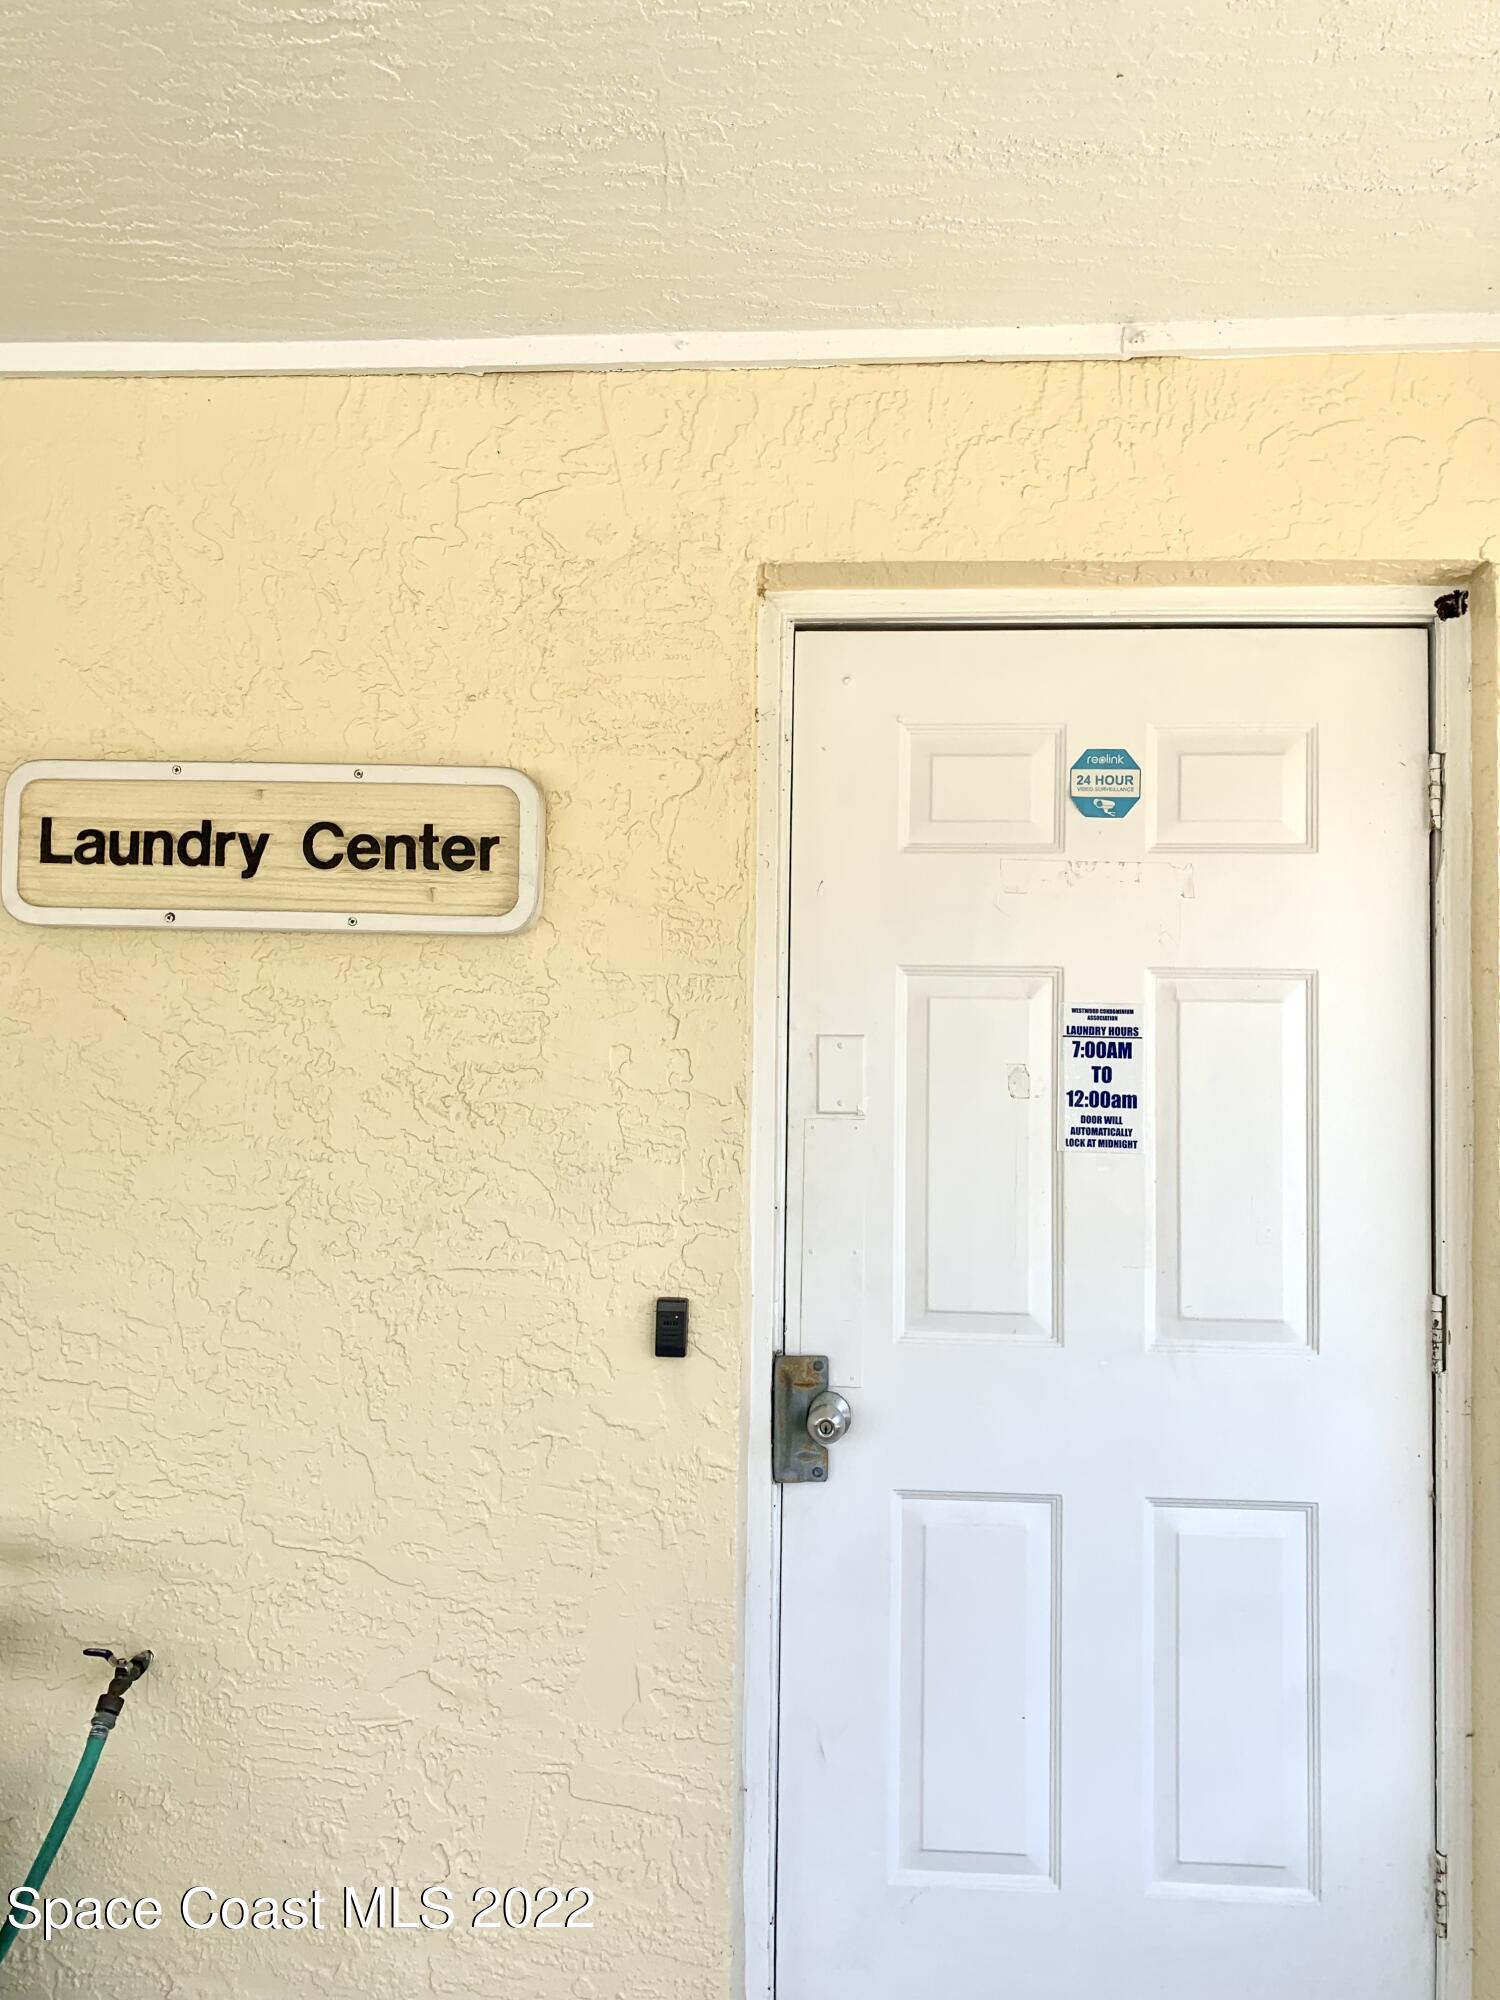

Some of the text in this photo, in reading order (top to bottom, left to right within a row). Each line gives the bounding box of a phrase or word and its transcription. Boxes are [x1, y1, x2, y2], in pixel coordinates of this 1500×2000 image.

[1087, 754, 1124, 764] reolink
[1076, 775, 1134, 785] 24 HOUR
[39, 817, 500, 879] Laundry Center
[1066, 1025, 1139, 1037] LAUNDRY HOURS
[1072, 1041, 1132, 1059] 7:00AM
[1091, 1066, 1112, 1083] TO
[1066, 1090, 1137, 1109] 12:00am
[1080, 1115, 1123, 1125] DOOR WILL
[1070, 1127, 1133, 1137] AUTOMATICALLY
[1065, 1138, 1138, 1149] LOCK AT MIDNIGHT
